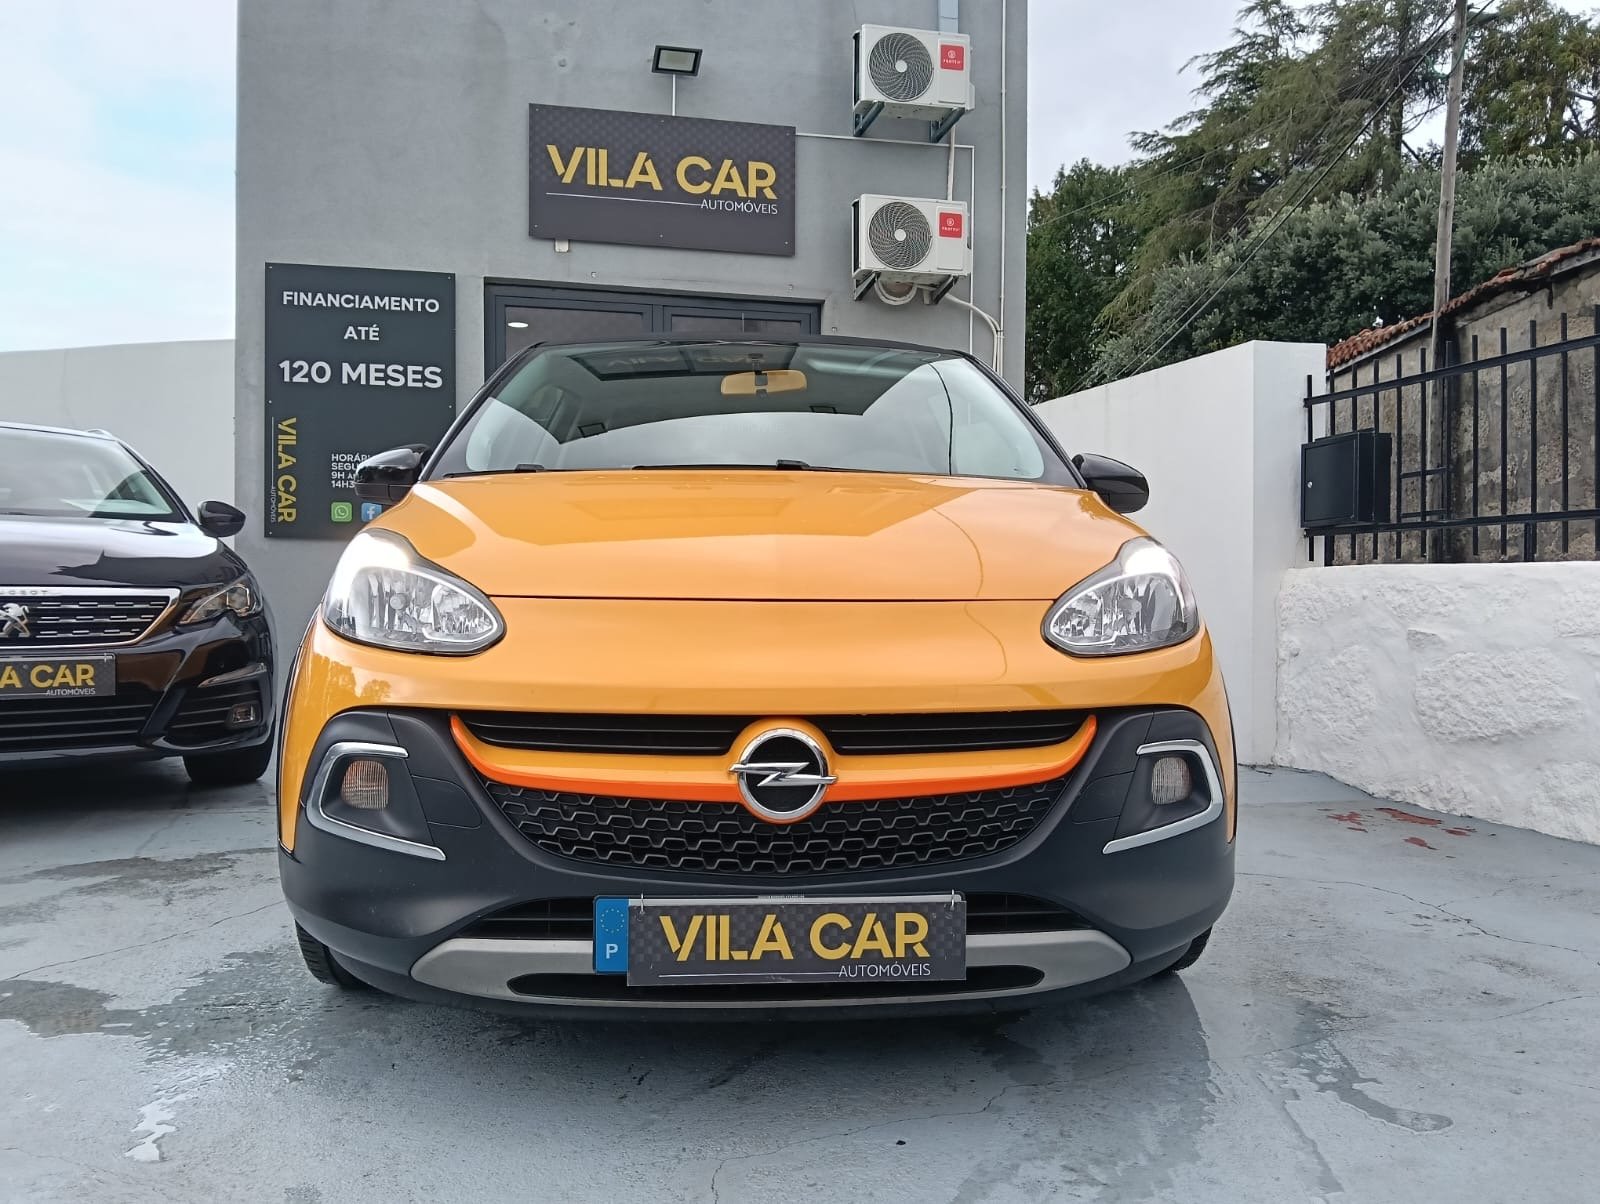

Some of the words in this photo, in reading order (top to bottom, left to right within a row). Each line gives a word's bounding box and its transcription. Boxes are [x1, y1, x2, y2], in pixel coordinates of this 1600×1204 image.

[546, 144, 663, 191] VILA
[675, 155, 778, 200] CAR
[700, 199, 778, 215] AUTOMÓVEIS
[282, 291, 440, 313] FINANCIAMENTO
[343, 324, 380, 341] ATÉ
[279, 360, 331, 384] 120
[342, 362, 443, 389] MESES
[277, 417, 297, 470] VILA
[331, 471, 345, 480] 9H
[277, 475, 297, 523] CAR
[30, 664, 96, 688] CAR
[659, 913, 794, 962] VILA
[809, 912, 930, 961] CAR
[605, 943, 619, 959] P
[838, 960, 931, 978] AUTOMÓVEIS
